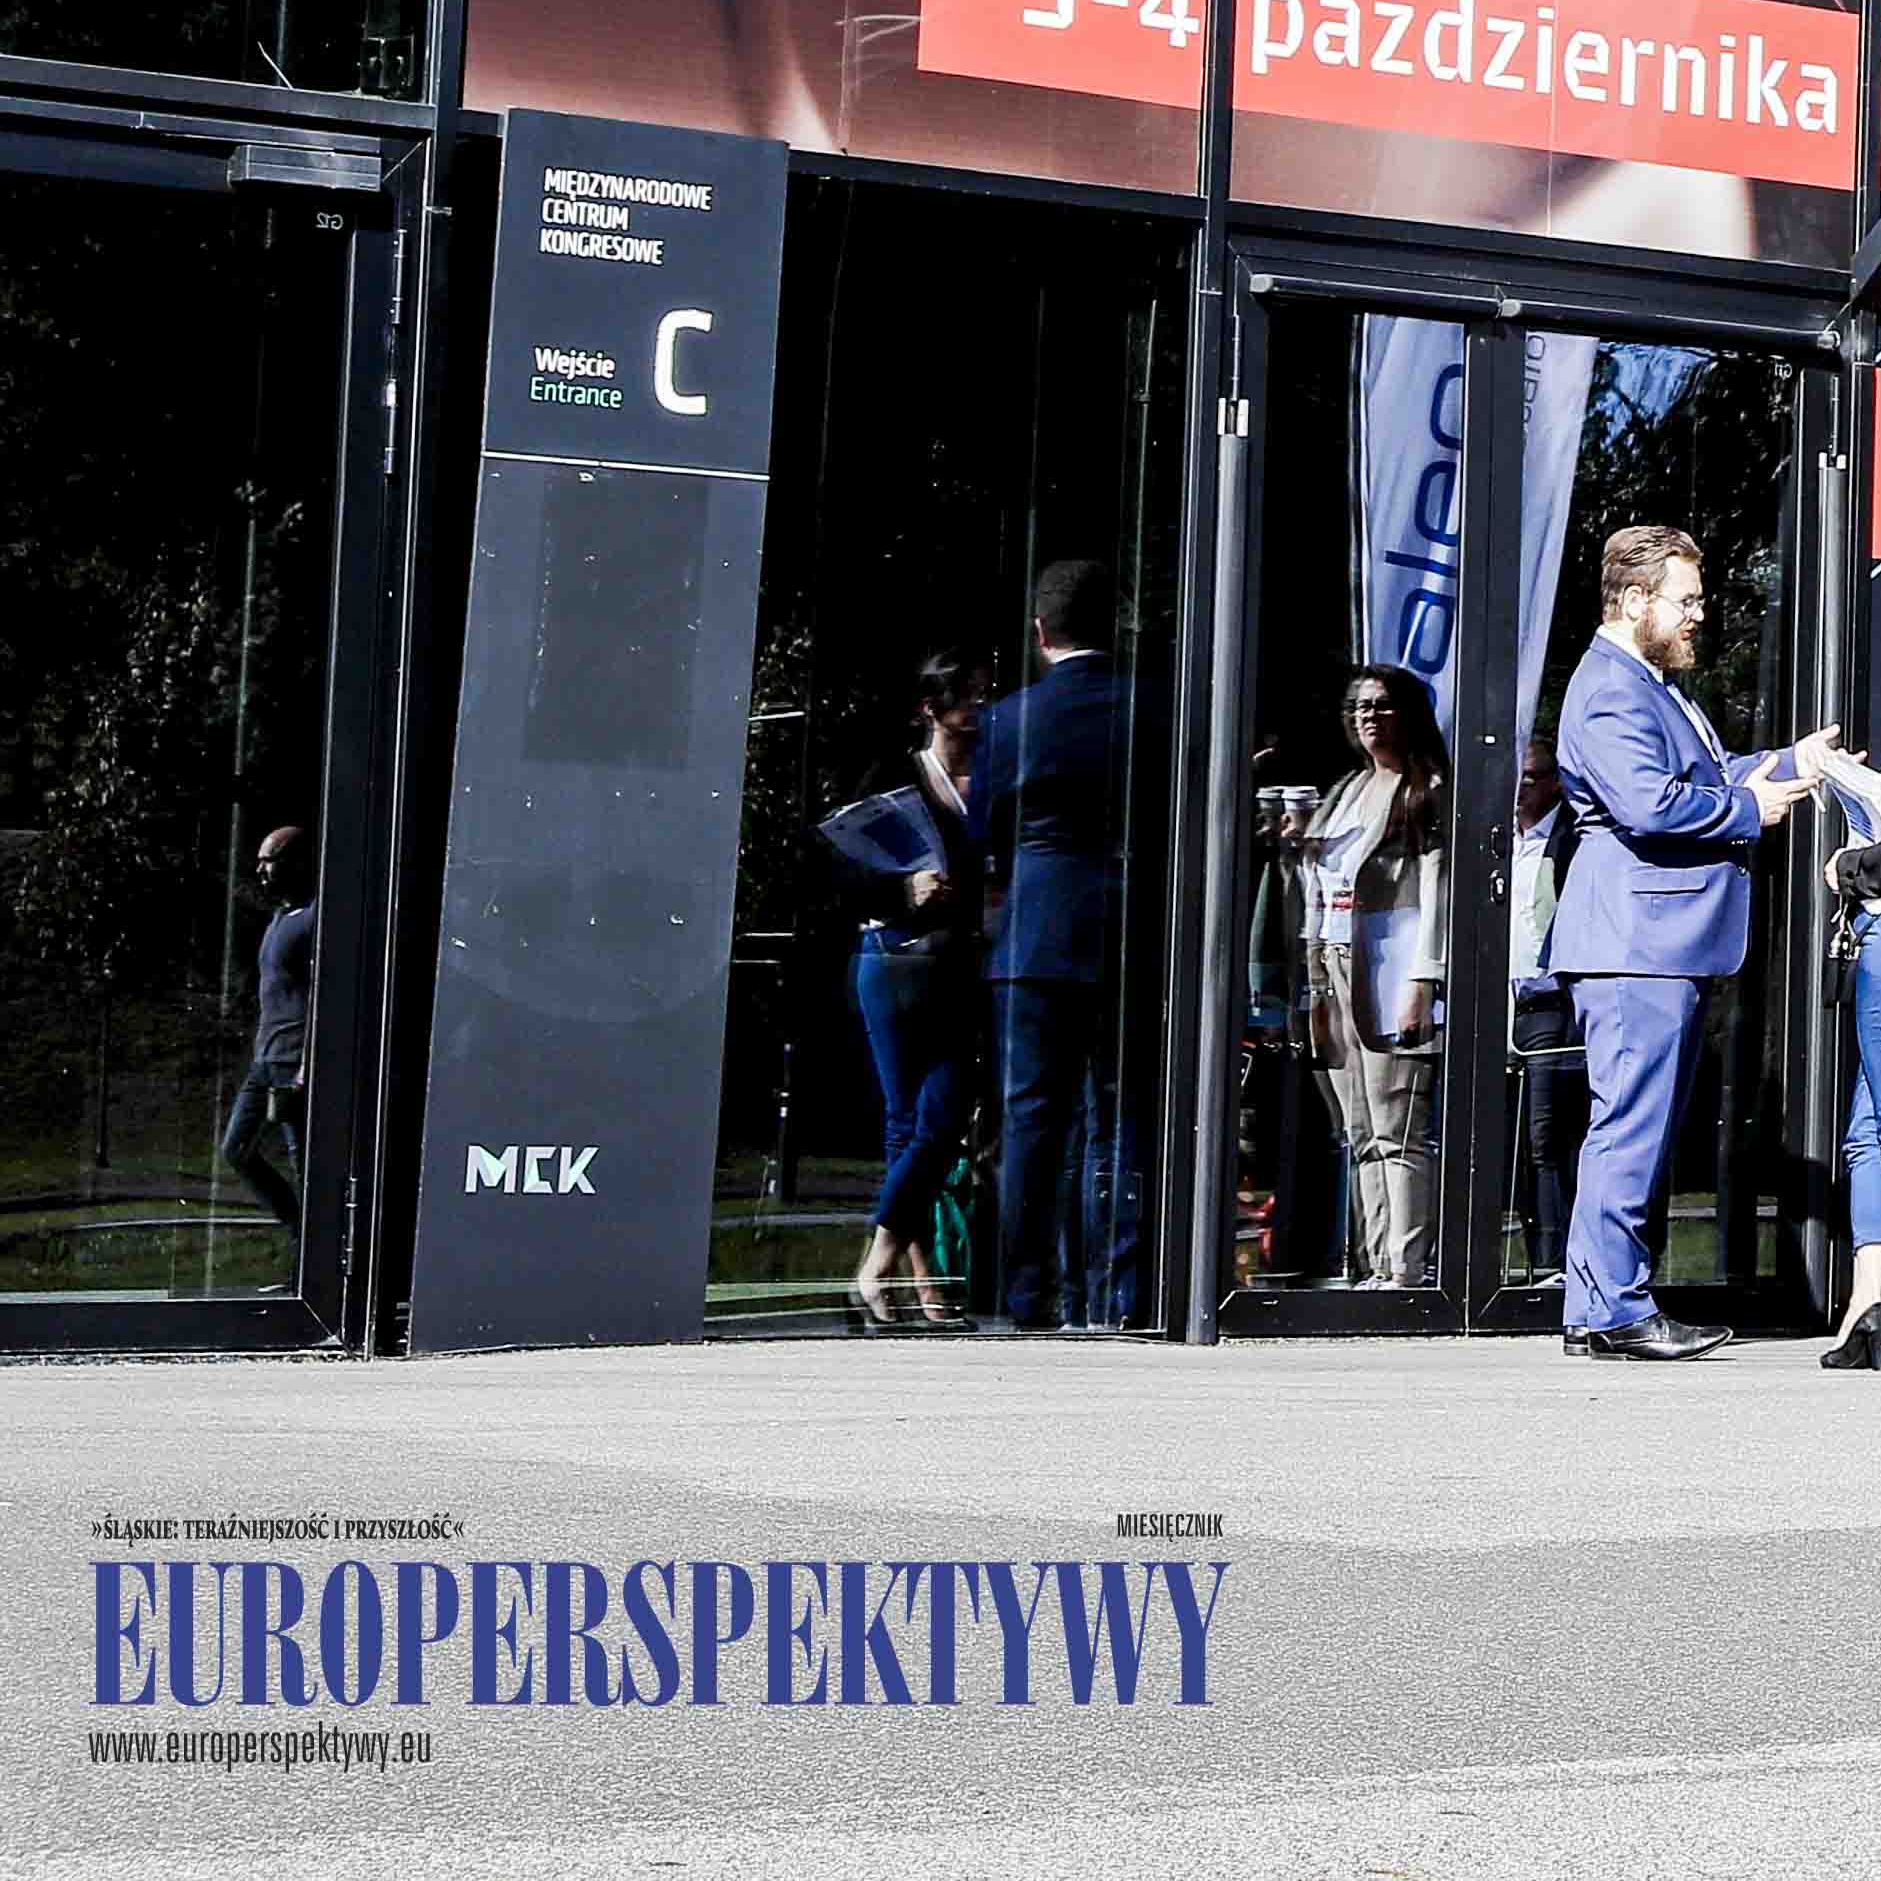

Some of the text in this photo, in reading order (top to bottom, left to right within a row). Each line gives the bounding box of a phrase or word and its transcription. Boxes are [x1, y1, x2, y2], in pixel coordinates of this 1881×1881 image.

[543, 168, 712, 210] MIĘDZYNARODOWE
[541, 198, 629, 231] CENTRUM
[540, 228, 664, 265] KONGRESOWE
[533, 346, 616, 381] Wejście
[654, 309, 713, 415] C
[529, 376, 623, 409] Entrance
[464, 1144, 600, 1195] MCK
